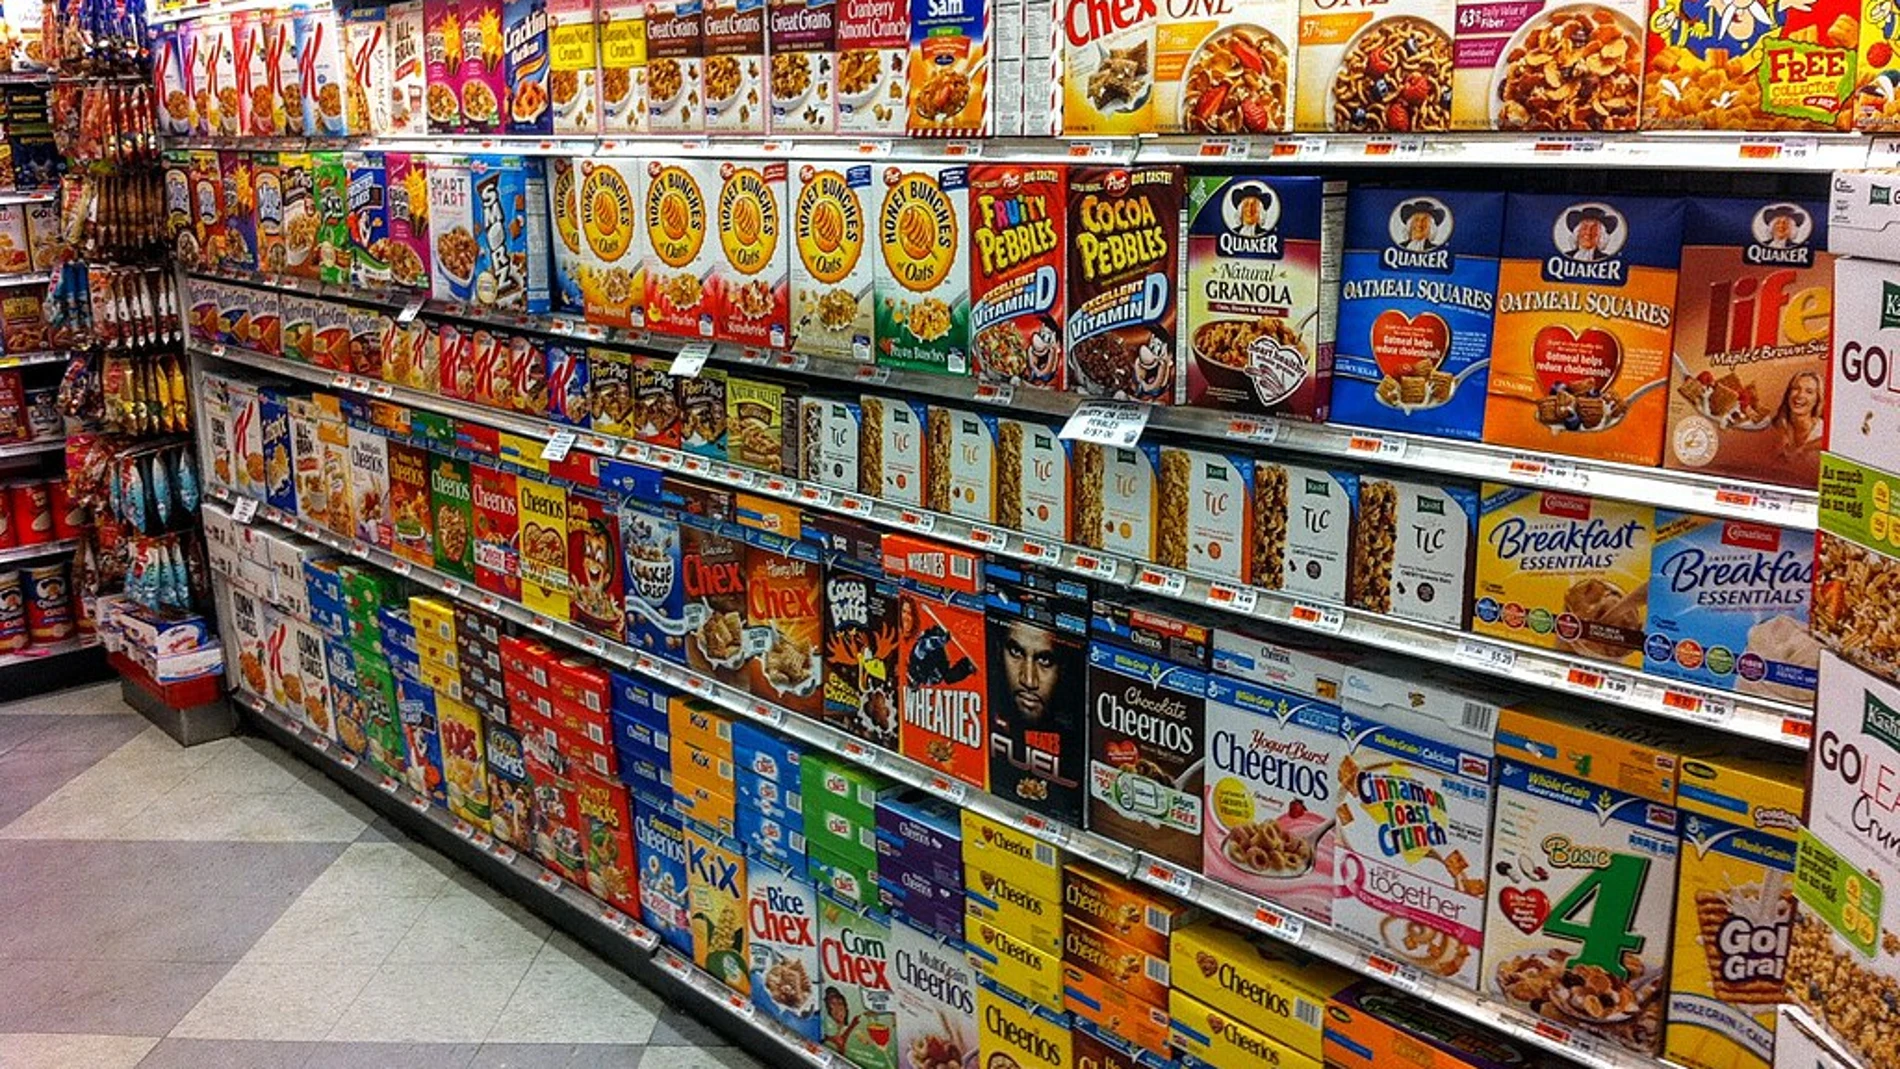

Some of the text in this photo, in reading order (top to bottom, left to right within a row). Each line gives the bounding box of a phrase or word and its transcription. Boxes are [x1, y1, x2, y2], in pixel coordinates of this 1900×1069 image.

[771, 9, 832, 33] Great Grains
[848, 0, 896, 18] Cranberry
[926, 0, 966, 17] Sam
[1480, 18, 1505, 28] Fiber
[648, 18, 699, 40] Great Grains
[705, 14, 762, 37] Great Grains
[838, 20, 872, 39] Almond
[871, 18, 907, 38] Crunch
[1065, 0, 1158, 47] Chex
[1768, 47, 1845, 84] FREE
[431, 177, 465, 193] SMART
[1107, 172, 1128, 193] Post
[431, 189, 465, 208] START
[583, 171, 631, 227] HONEY BUNCHES
[649, 172, 701, 231] HONEY BUNCHES
[722, 175, 774, 236] HONEY BUNCHES
[800, 178, 858, 243] HONEY BUNCHES
[885, 180, 951, 249] HONEY BUNCHES
[1081, 195, 1157, 234] COCOA
[599, 238, 619, 252] Oats
[665, 242, 688, 258] Oats
[737, 246, 760, 266] Oats
[975, 219, 1058, 277] PEBBLES
[1076, 226, 1169, 281] PEBBLES
[1219, 234, 1279, 255] QUAKER
[1383, 247, 1449, 270] QUAKER
[1747, 244, 1809, 264] QUAKER
[816, 254, 842, 274] Oats
[905, 262, 935, 283] Oats
[1220, 262, 1277, 282] Natural
[1547, 256, 1621, 280] QUAKER
[974, 265, 1058, 329] VITAMIN D
[983, 272, 1036, 303] EXCELLENT
[1082, 281, 1144, 310] EXCELLENT
[1205, 280, 1293, 305] GRANOLA
[1343, 278, 1493, 312] OATMEAL SQUARES
[1071, 272, 1169, 339] VITAMIN D
[1500, 289, 1671, 328] OATMEAL SQUARES
[1706, 270, 1831, 357] life
[1376, 346, 1398, 355] reduce
[1383, 335, 1434, 349] Oatmeal helps
[1536, 361, 1562, 373] reduce
[1545, 350, 1604, 367] Oatmeal helps
[1711, 343, 1806, 371] Maple Brown
[351, 445, 385, 475] Cheerios
[431, 469, 471, 501] Cheerios
[1821, 466, 1863, 484] As much
[473, 484, 517, 516] Cheerios
[521, 487, 565, 520] Cheerios
[1203, 489, 1228, 517] TLC
[1820, 482, 1858, 500] protein
[1302, 506, 1331, 534] TLC
[1820, 498, 1864, 520] as an egg
[1412, 524, 1446, 554] TLC
[1488, 517, 1646, 560] Breakfast
[682, 554, 746, 597] Chex
[907, 551, 946, 580] WHEATIES
[1519, 553, 1613, 571] ESSENTIALS
[750, 576, 816, 621] Chex
[827, 576, 868, 605] Cocoa
[1697, 588, 1804, 606] ESSENTIALS
[829, 599, 869, 625] Puffs
[902, 684, 983, 750] WHEATIES
[1124, 686, 1188, 721] Chocolate
[1096, 691, 1194, 756] Cheerios
[1024, 729, 1061, 754] WHEATIES
[1249, 729, 1330, 766] Yogurt Burst
[989, 732, 1080, 788] FUEL
[1211, 730, 1329, 801] Cheerios
[1421, 747, 1456, 768] Calcium
[1357, 771, 1448, 814] Cinnamon
[1527, 771, 1591, 800] Whole Grain
[1527, 784, 1585, 807] Guaranteed
[1170, 808, 1196, 825] FREE
[1383, 800, 1432, 828] Toast
[635, 815, 686, 864] Cheerios
[899, 822, 930, 847] Cheerios
[992, 831, 1032, 860] Cheerios
[1378, 821, 1448, 858] Crunch
[1542, 833, 1611, 868] Basic
[901, 872, 932, 897] Cheerios
[992, 877, 1043, 916] Cheerios
[1369, 868, 1467, 921] together
[767, 886, 805, 915] Rice
[1542, 850, 1651, 980] 4
[749, 898, 816, 948] Chex
[840, 928, 886, 959] Corn
[994, 934, 1042, 971] Cheerios
[822, 937, 893, 991] Chex
[895, 950, 974, 1015] Cheerios
[1217, 963, 1291, 1019] Cheerios
[1672, 1001, 1739, 1032] WHOLE GRAIN
[985, 1004, 1062, 1067] Cheerios
[1222, 1021, 1281, 1067] Cheerios
